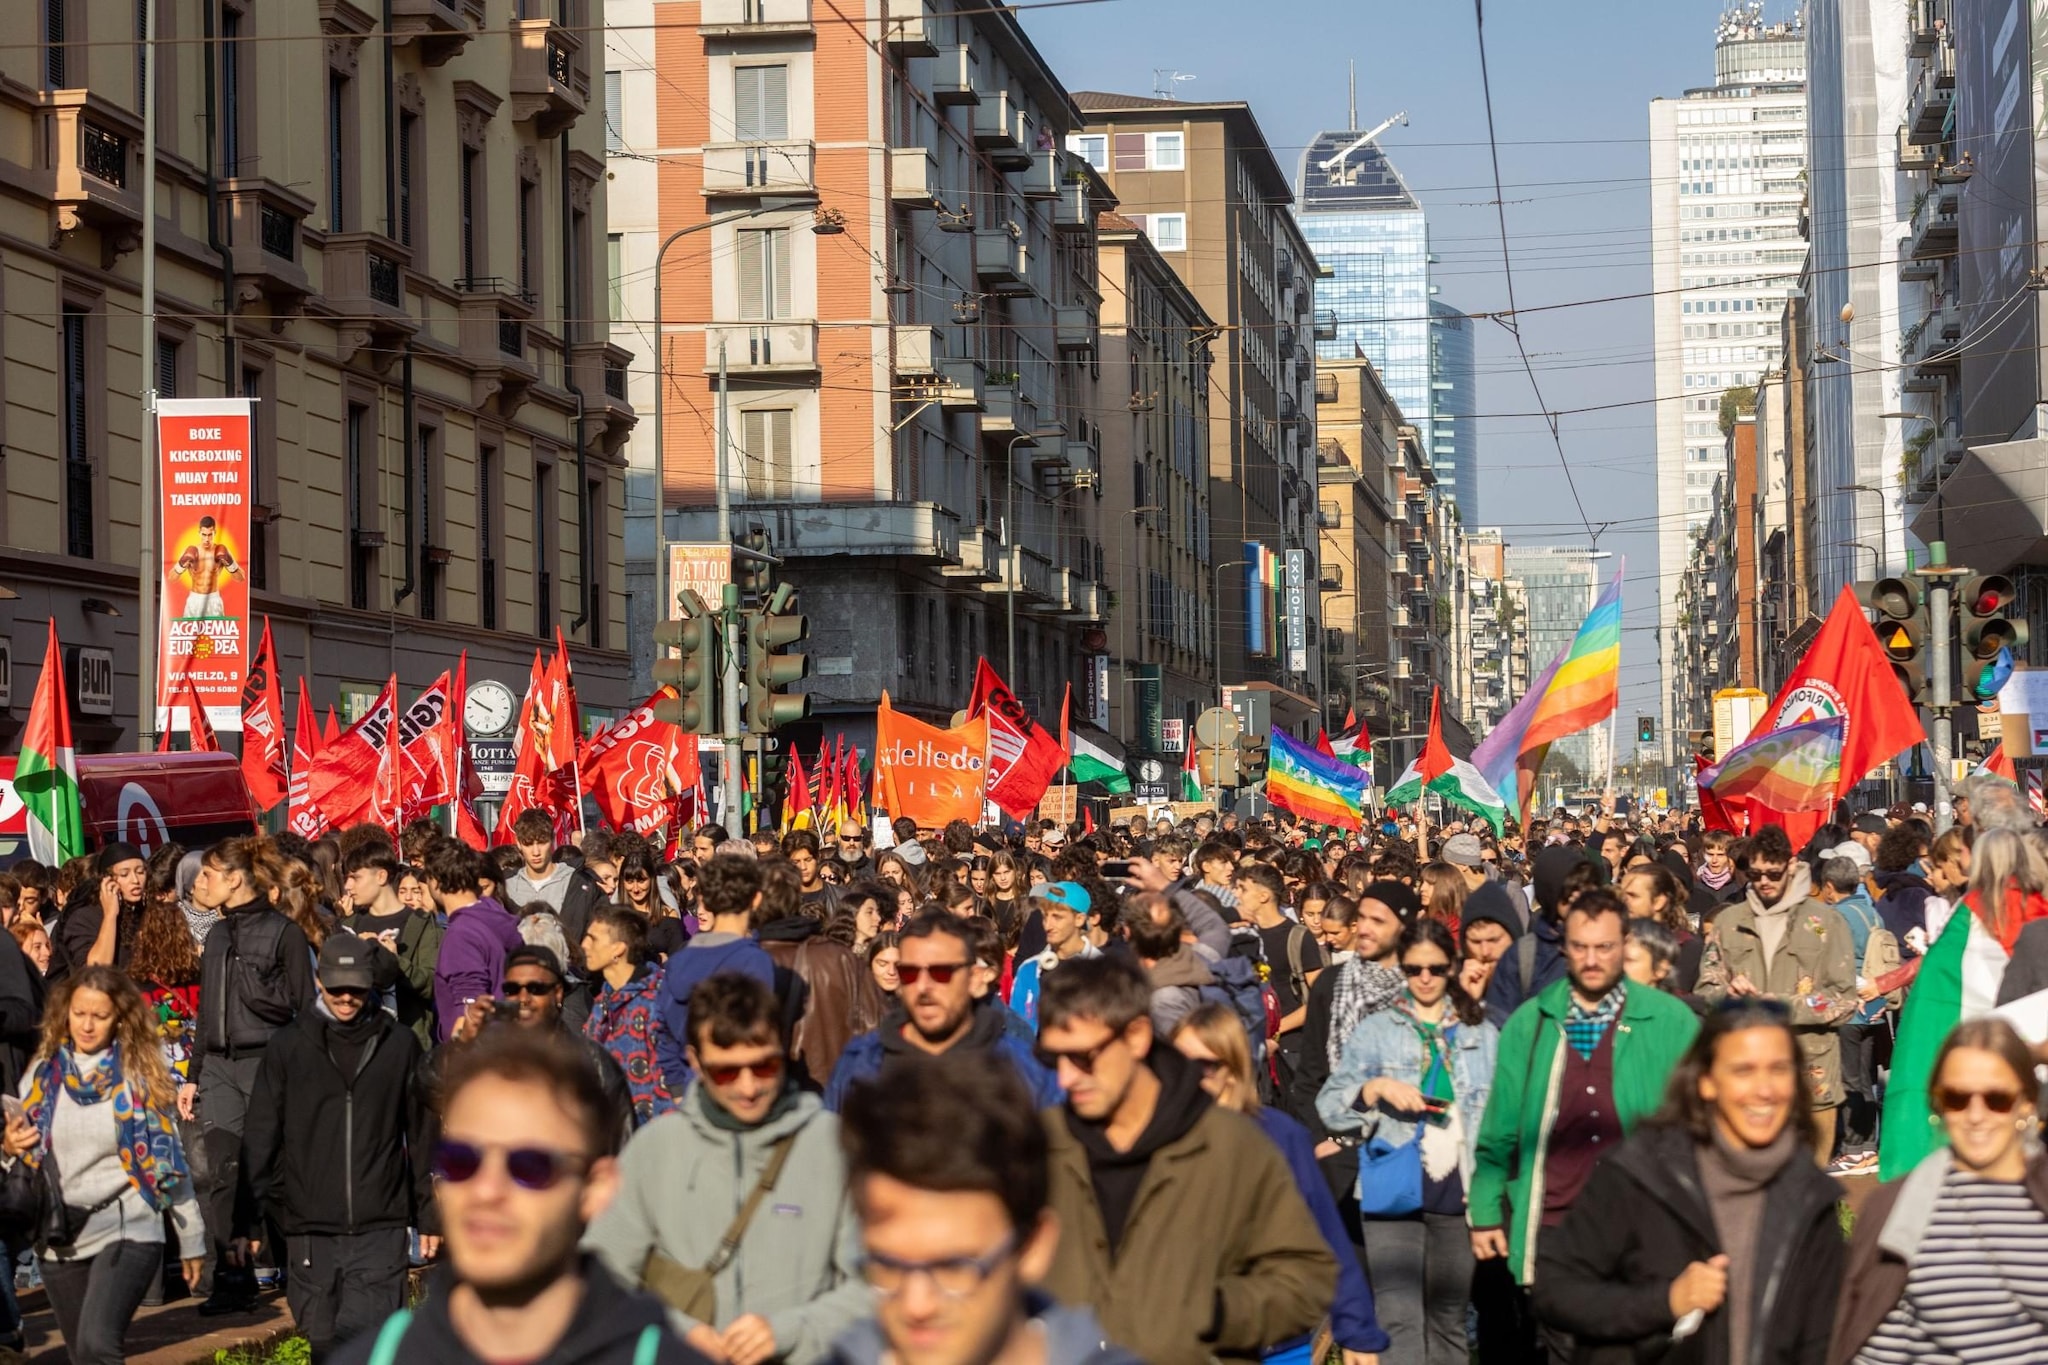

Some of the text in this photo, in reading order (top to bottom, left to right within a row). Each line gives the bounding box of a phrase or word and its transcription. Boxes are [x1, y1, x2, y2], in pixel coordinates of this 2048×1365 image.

[189, 428, 222, 440] BOXE
[169, 449, 242, 462] KICKBOXING
[174, 471, 238, 484] MUAY THAI
[170, 493, 241, 506] TAEKWONDO
[675, 560, 728, 580] TATTOO
[170, 620, 239, 636] ACCADEMIA
[168, 671, 238, 682] VIA MELZO, 9
